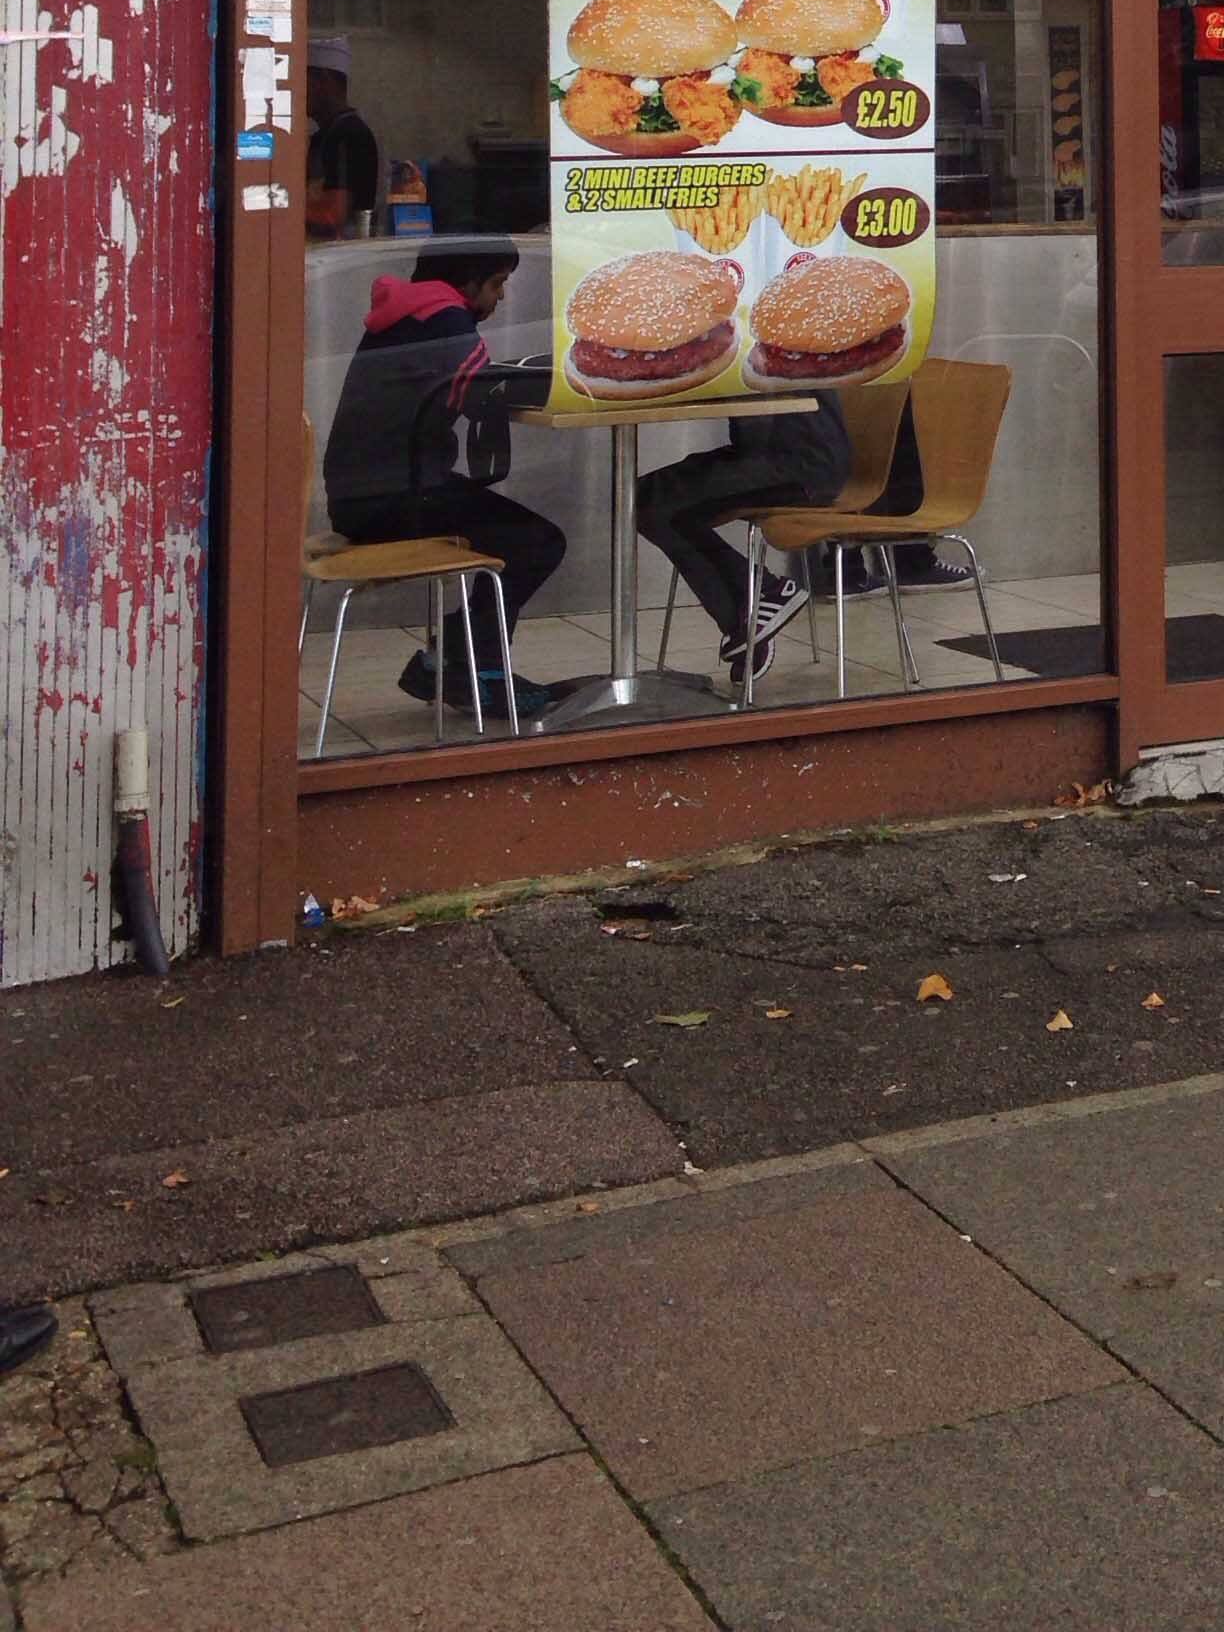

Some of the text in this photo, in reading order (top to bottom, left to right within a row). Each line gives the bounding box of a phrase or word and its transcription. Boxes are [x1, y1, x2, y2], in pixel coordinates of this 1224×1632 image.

[856, 90, 917, 129] £2.50
[566, 165, 767, 191] 2 MINI BEEF BURGERS
[566, 188, 719, 212] & 2 SMALL FRIES
[855, 198, 917, 237] £3.00
